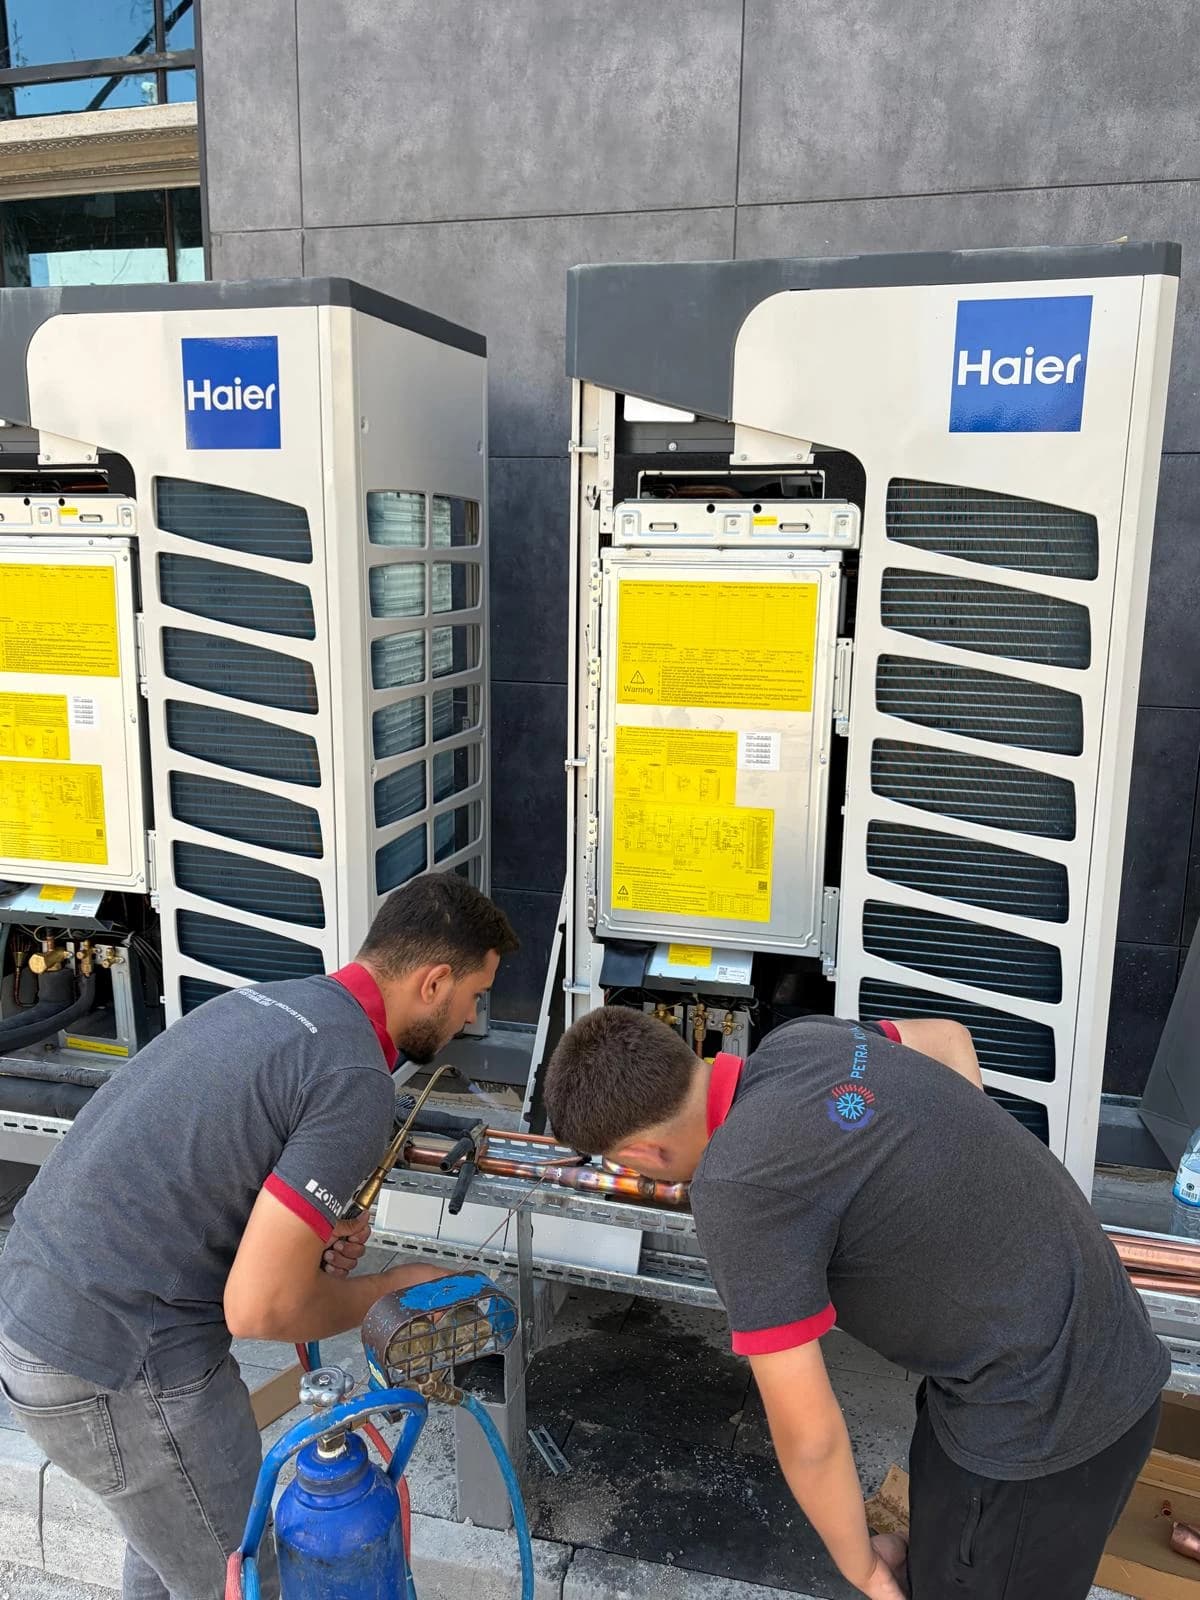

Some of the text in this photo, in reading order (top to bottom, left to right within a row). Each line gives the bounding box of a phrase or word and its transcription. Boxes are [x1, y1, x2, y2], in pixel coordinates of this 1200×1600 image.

[957, 346, 1082, 386] Haier
[186, 377, 276, 411] Haier
[623, 684, 654, 695] Warning
[850, 1044, 869, 1079] PETRA
